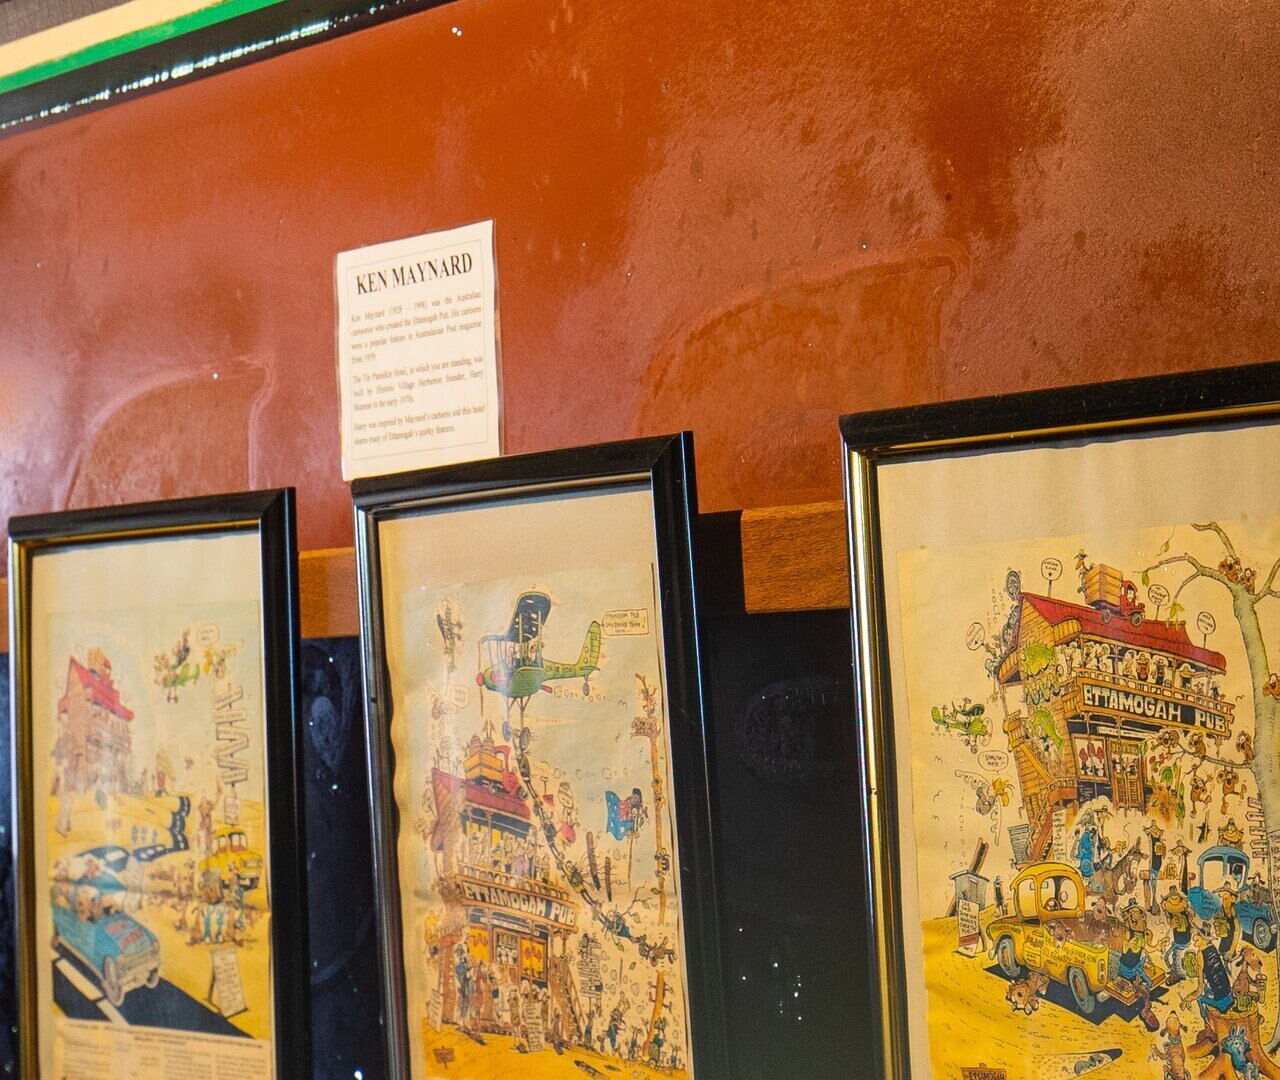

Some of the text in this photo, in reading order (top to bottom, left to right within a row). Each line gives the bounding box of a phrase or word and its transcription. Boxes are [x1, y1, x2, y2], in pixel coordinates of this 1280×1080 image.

[355, 251, 473, 296] KEN MAYNARD
[1083, 684, 1226, 732] ETTAMOGAH PUB
[550, 903, 575, 926] PUB
